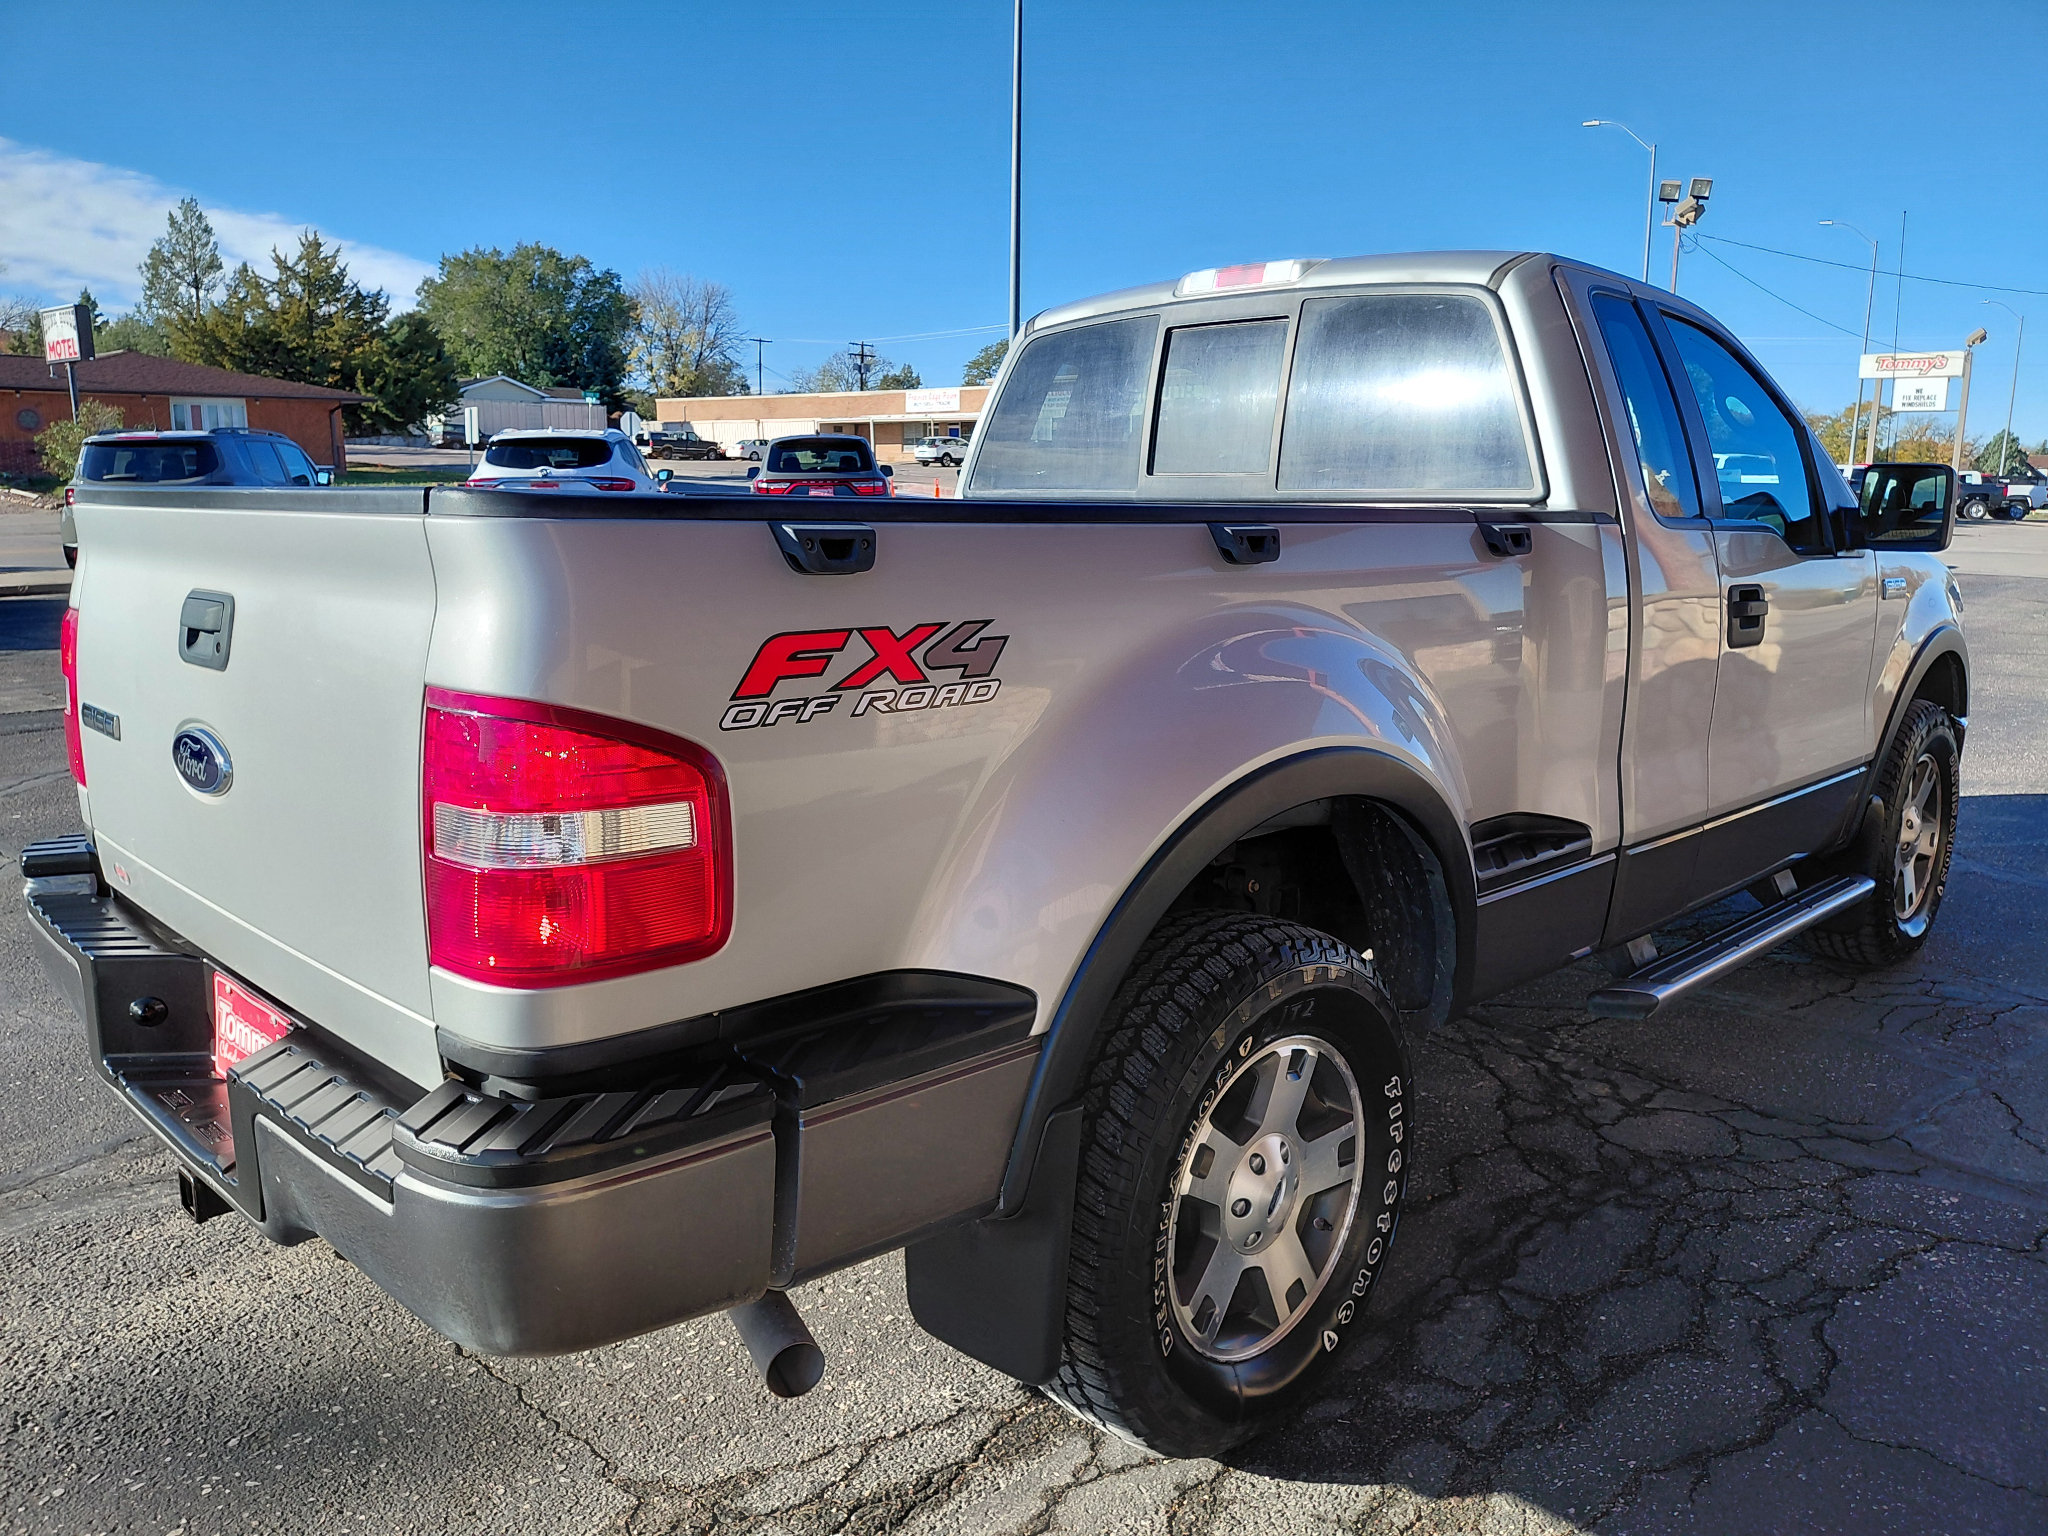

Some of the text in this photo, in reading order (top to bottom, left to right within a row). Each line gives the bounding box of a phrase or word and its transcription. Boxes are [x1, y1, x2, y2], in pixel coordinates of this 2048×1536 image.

[48, 338, 77, 359] MOTEL
[1877, 355, 1948, 375] Tommy's
[729, 619, 1010, 701] FX4
[719, 678, 1001, 731] OFF ROAD
[177, 737, 208, 781] Ford
[219, 997, 272, 1055] Tomm
[1337, 1075, 1403, 1325] Firestone
